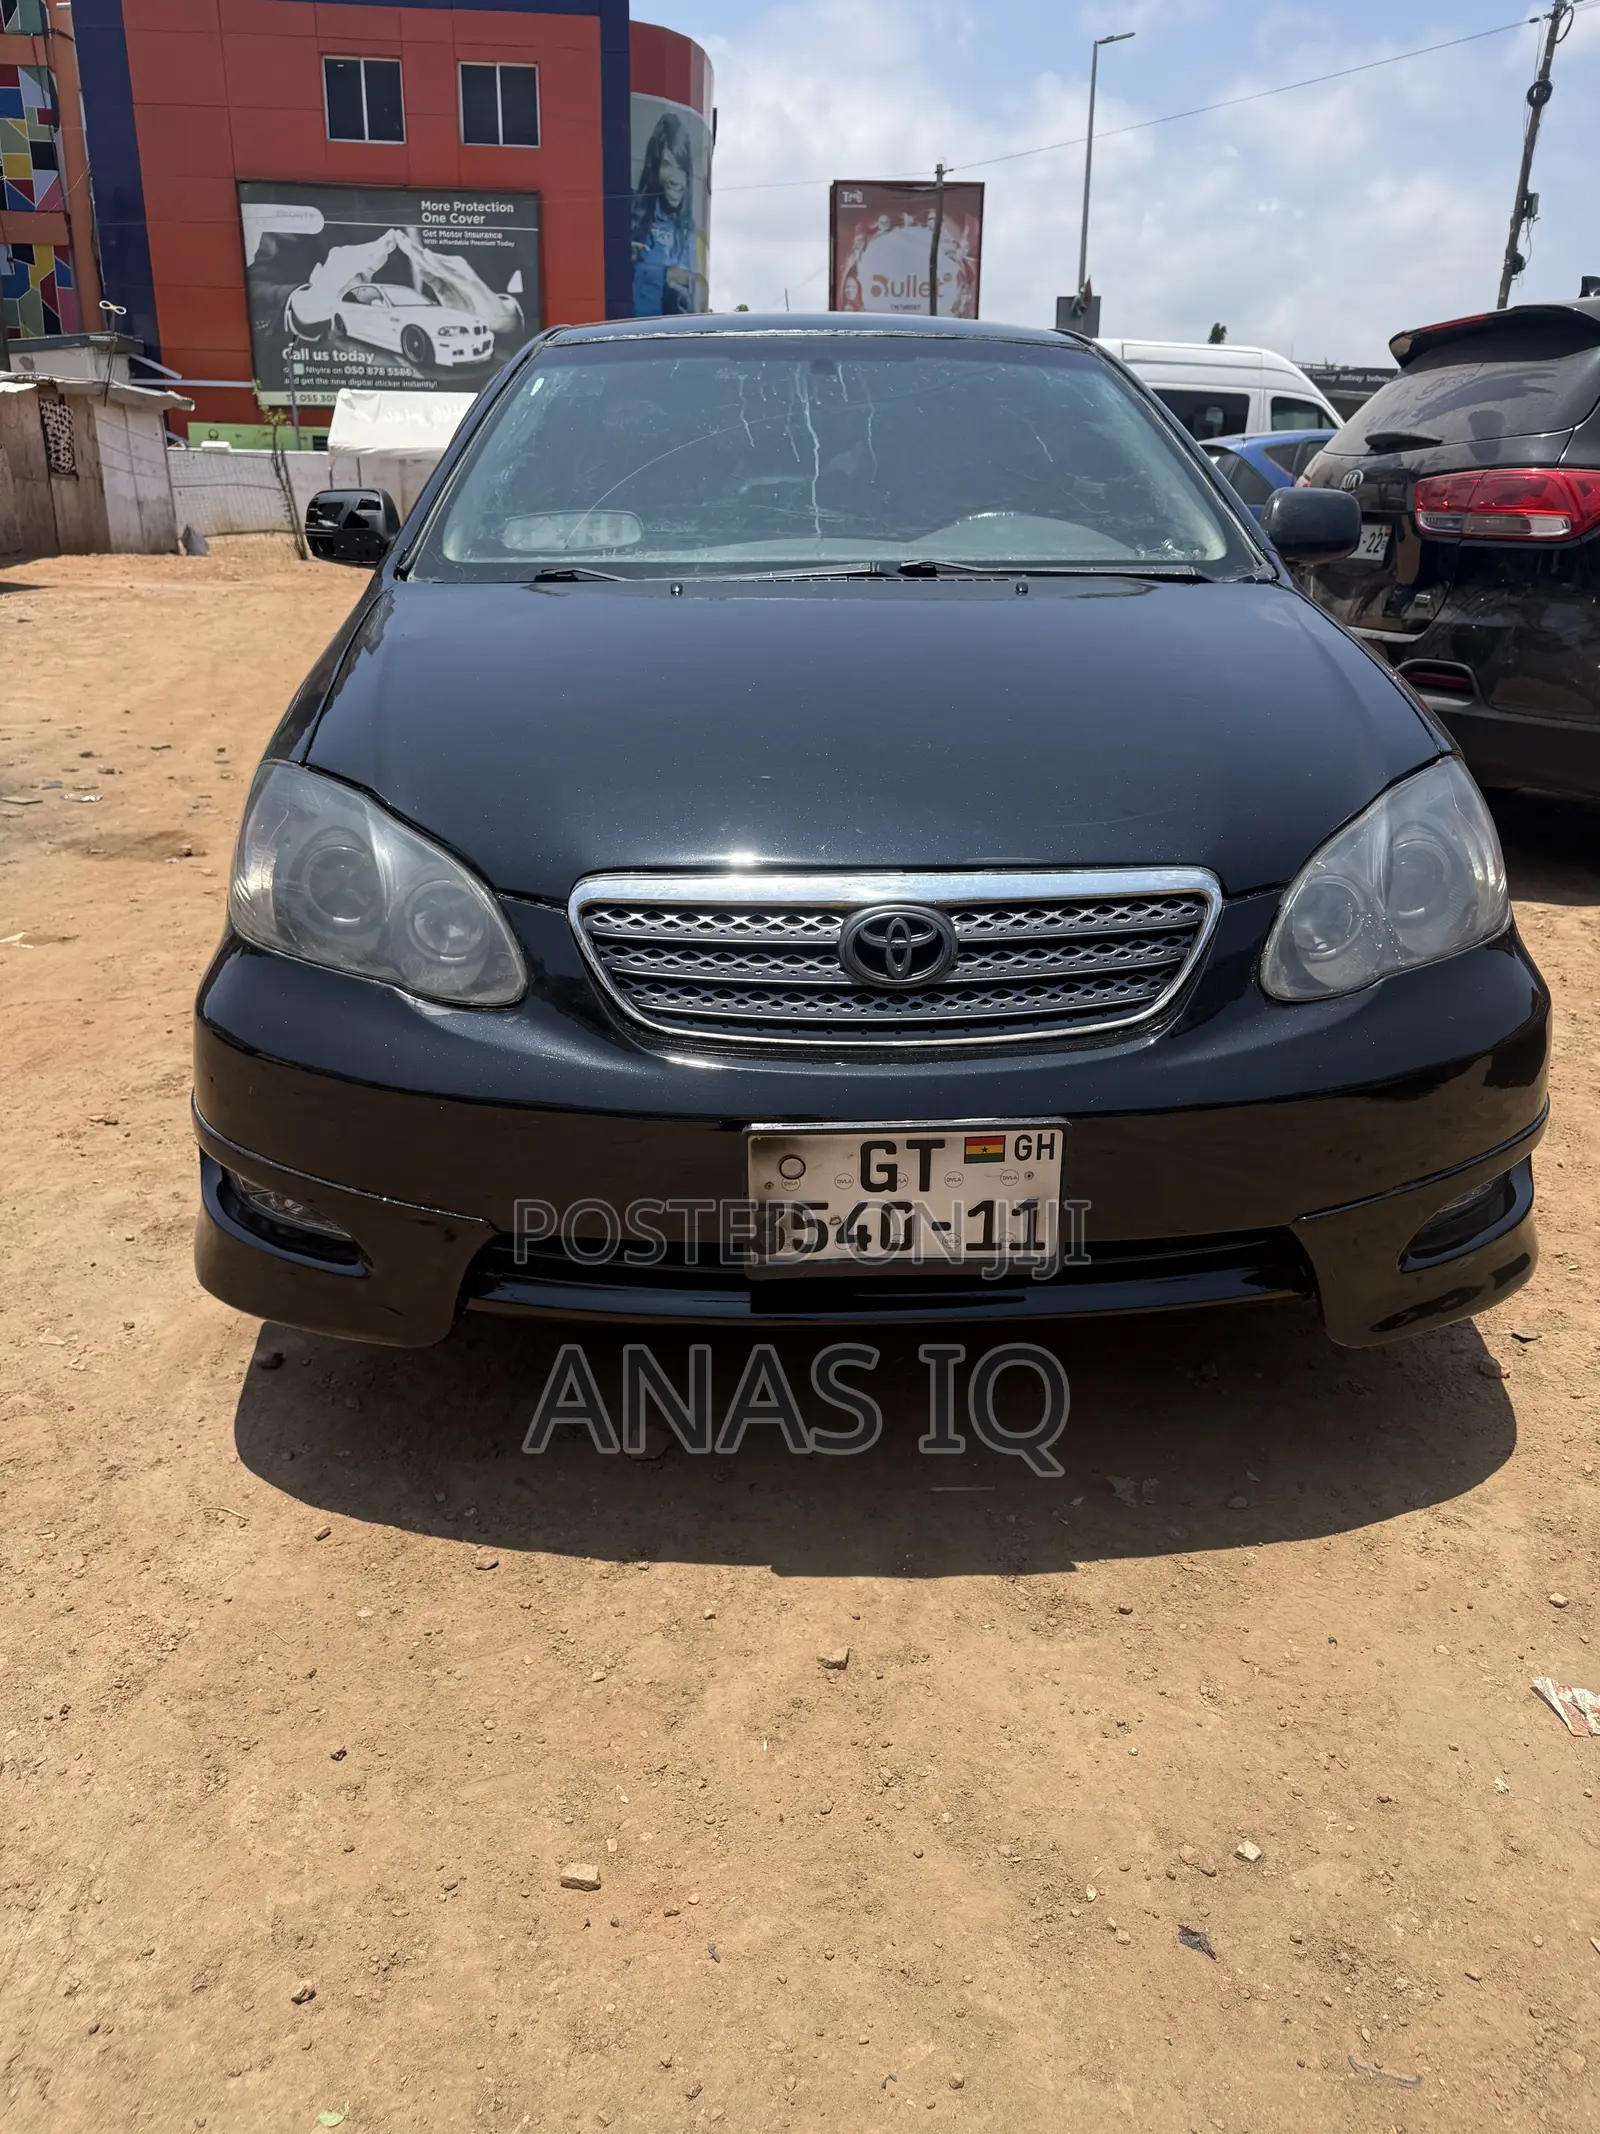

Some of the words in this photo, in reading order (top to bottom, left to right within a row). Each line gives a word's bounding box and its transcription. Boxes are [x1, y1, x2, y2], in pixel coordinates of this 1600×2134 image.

[420, 200, 451, 212] More
[453, 201, 514, 213] Protection
[421, 212, 447, 224] One
[449, 212, 486, 224] Cover
[422, 230, 437, 238] Get
[438, 230, 463, 238] Motor
[464, 231, 503, 239] Insurance
[282, 348, 310, 361] Call
[313, 351, 330, 361] us
[332, 350, 375, 364] today
[284, 377, 300, 385] ad
[1013, 1132, 1056, 1162] GH
[859, 1139, 946, 1193] GT
